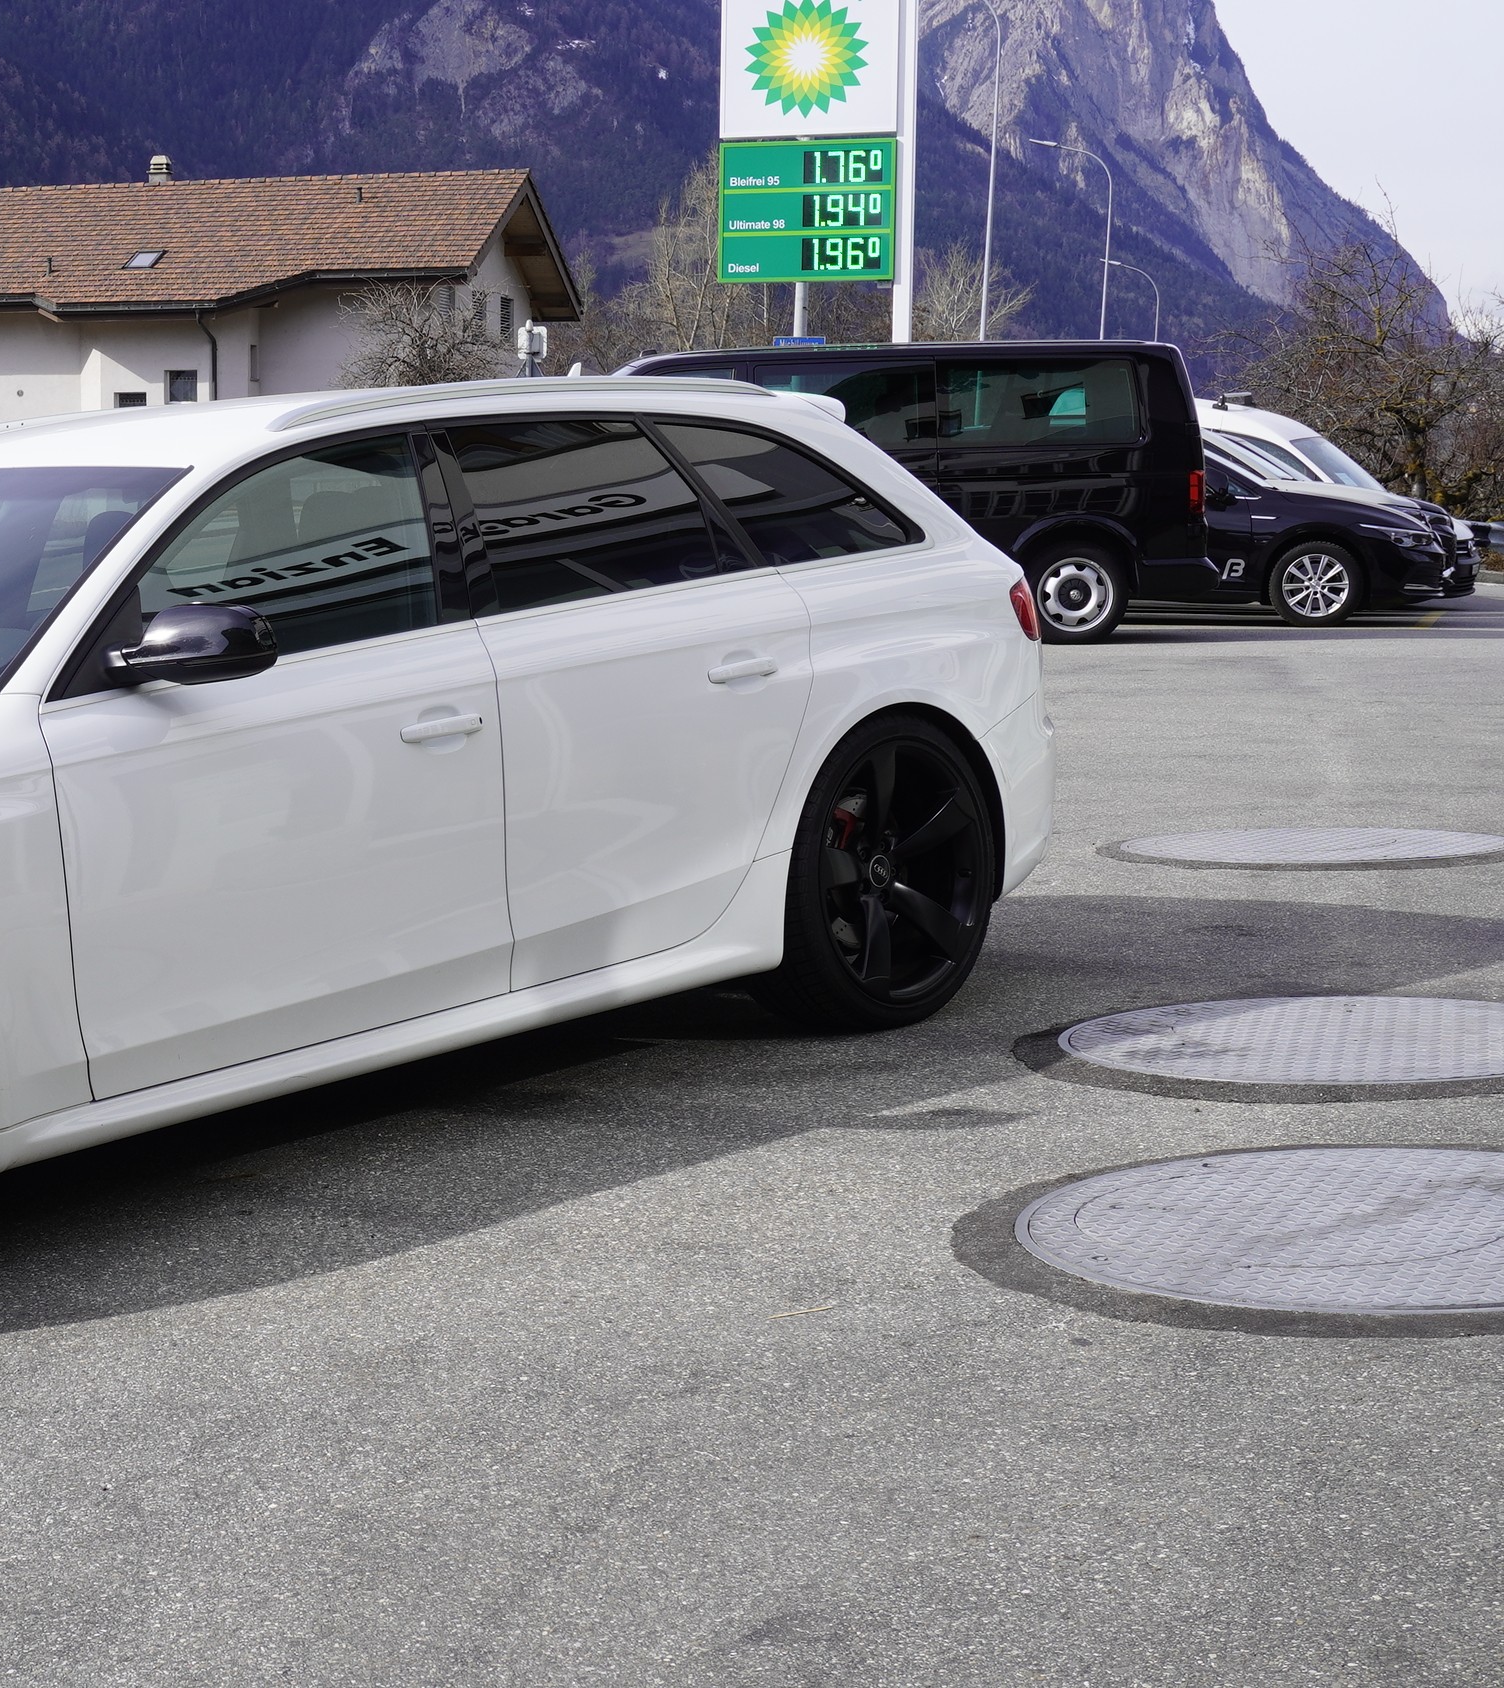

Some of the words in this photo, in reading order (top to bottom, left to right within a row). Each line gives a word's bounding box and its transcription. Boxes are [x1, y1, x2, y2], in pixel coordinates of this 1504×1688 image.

[729, 176, 765, 187] Bleifrei
[767, 175, 780, 186] 95
[729, 220, 771, 230] Ultimate
[772, 219, 785, 229] 98
[728, 263, 759, 273] Diesel
